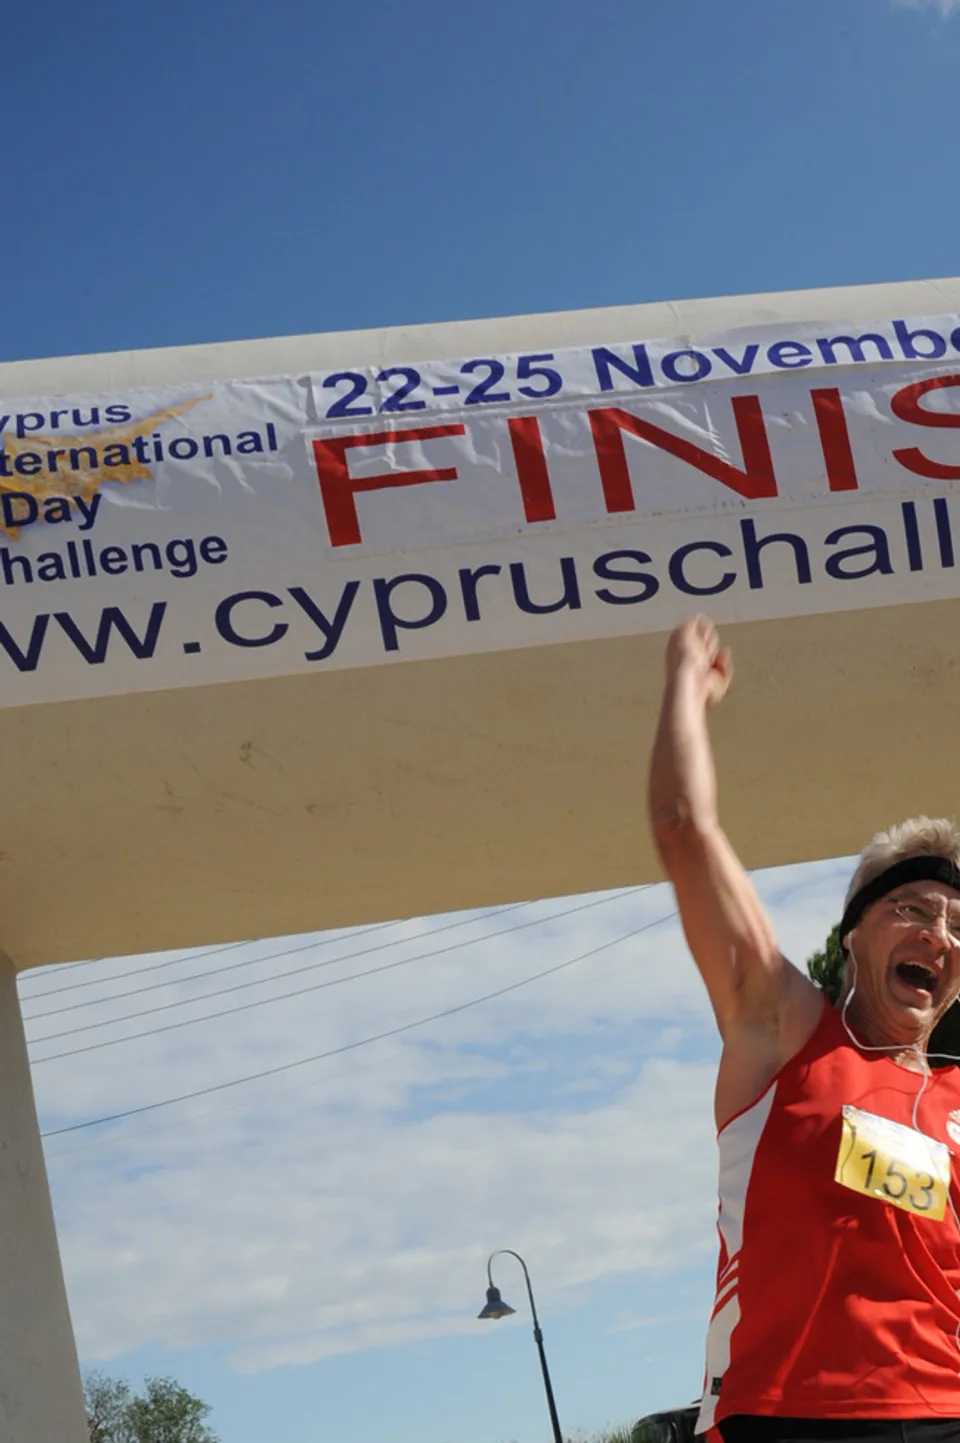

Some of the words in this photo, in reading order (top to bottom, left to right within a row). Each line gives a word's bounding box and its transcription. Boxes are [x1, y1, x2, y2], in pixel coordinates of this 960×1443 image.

[321, 353, 564, 419] 22-25
[1, 491, 102, 531] Day
[861, 1149, 935, 1210] 153
